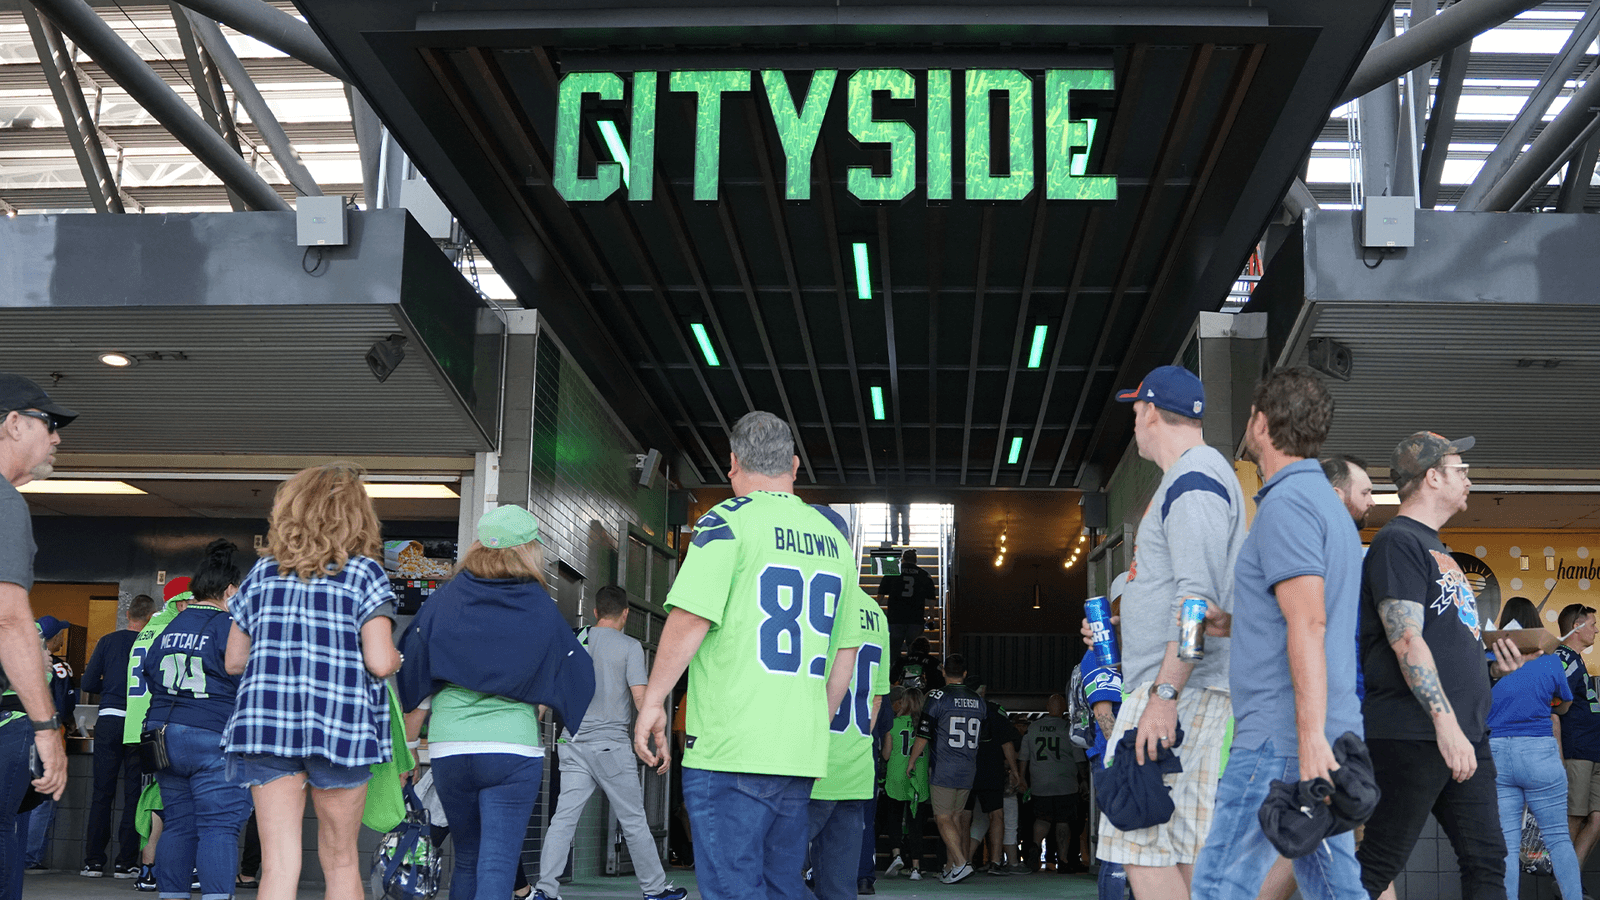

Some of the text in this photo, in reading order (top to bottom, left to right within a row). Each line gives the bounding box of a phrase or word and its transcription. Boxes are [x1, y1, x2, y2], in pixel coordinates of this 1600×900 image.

[552, 68, 1119, 202] CITYSIDE
[774, 527, 839, 559] BALDWIN
[901, 575, 915, 598] 3
[757, 563, 842, 679] 89
[160, 632, 209, 651] METCALF
[159, 653, 209, 699] 14
[954, 698, 979, 708] PETERSON
[948, 716, 981, 749] 59
[1035, 736, 1060, 761] 24
